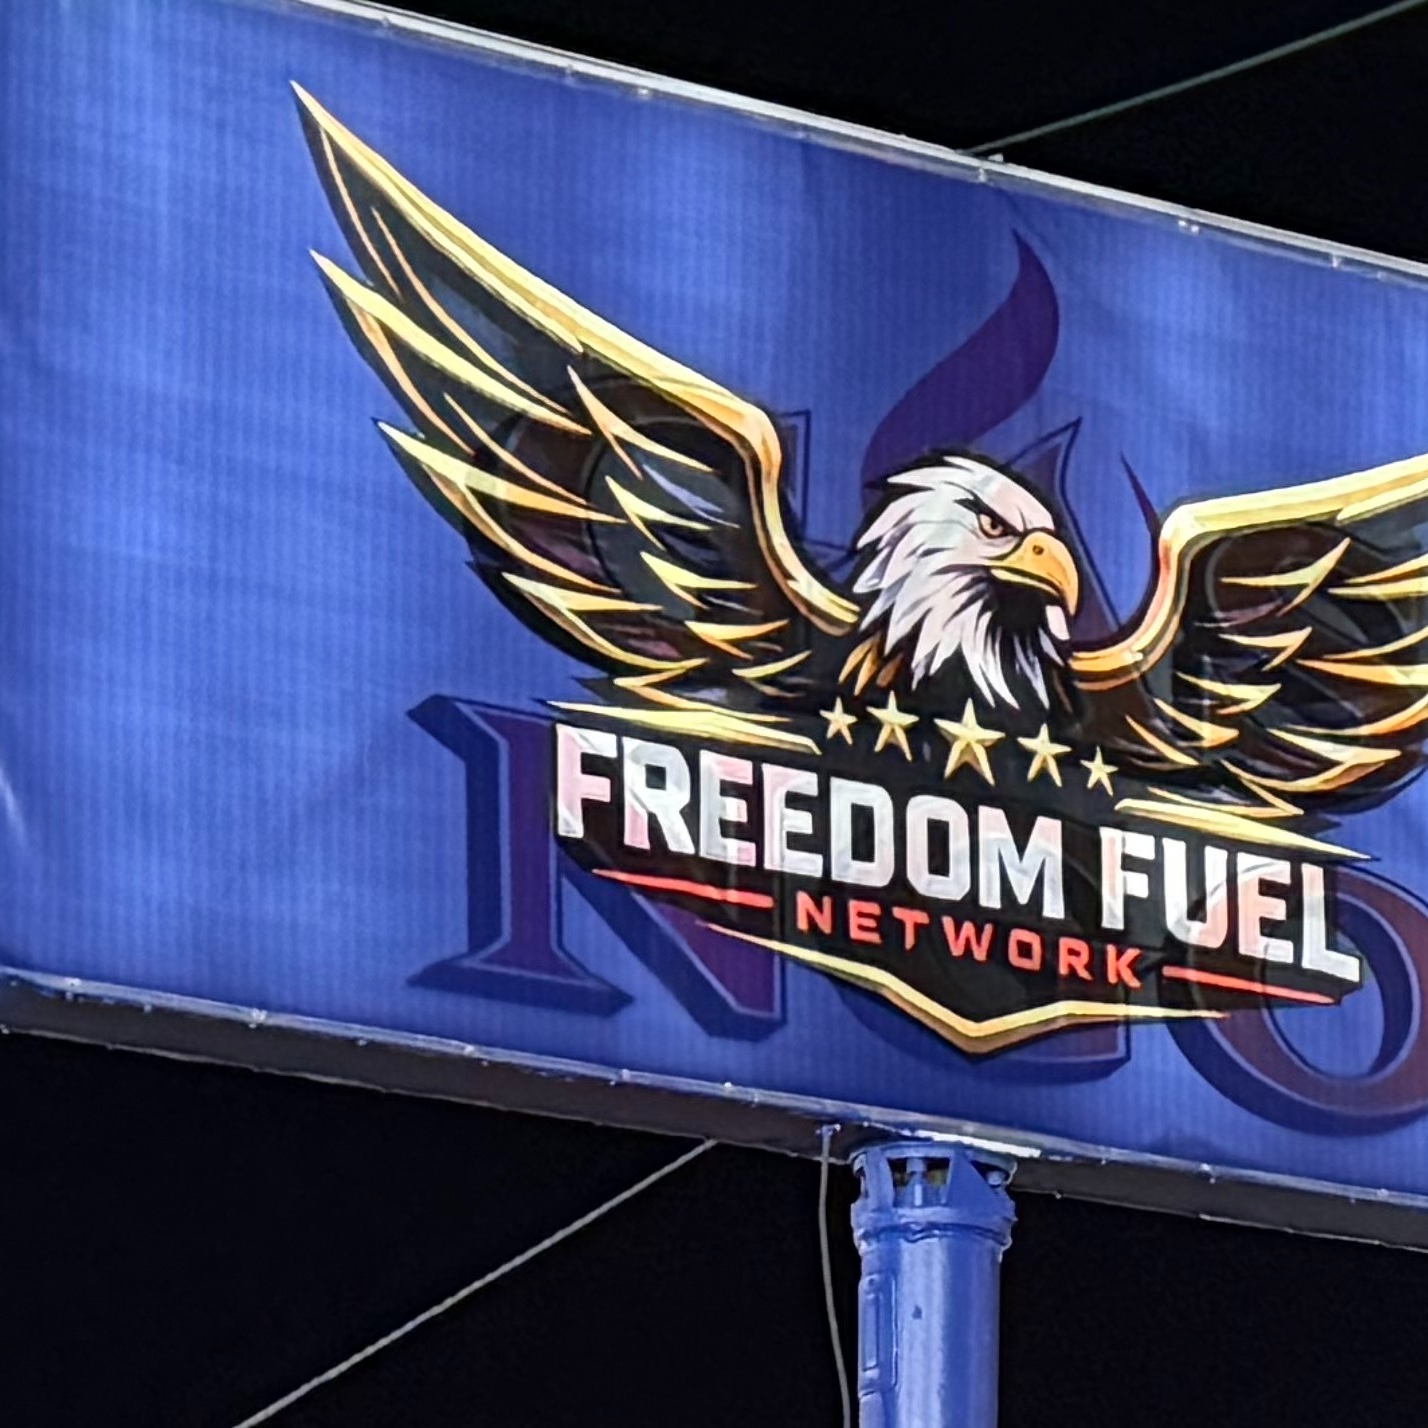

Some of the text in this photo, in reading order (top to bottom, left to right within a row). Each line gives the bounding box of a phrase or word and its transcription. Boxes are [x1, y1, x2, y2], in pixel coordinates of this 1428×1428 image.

[555, 721, 1363, 983] FREEDOM FUEL
[795, 893, 1143, 990] NETWORK
